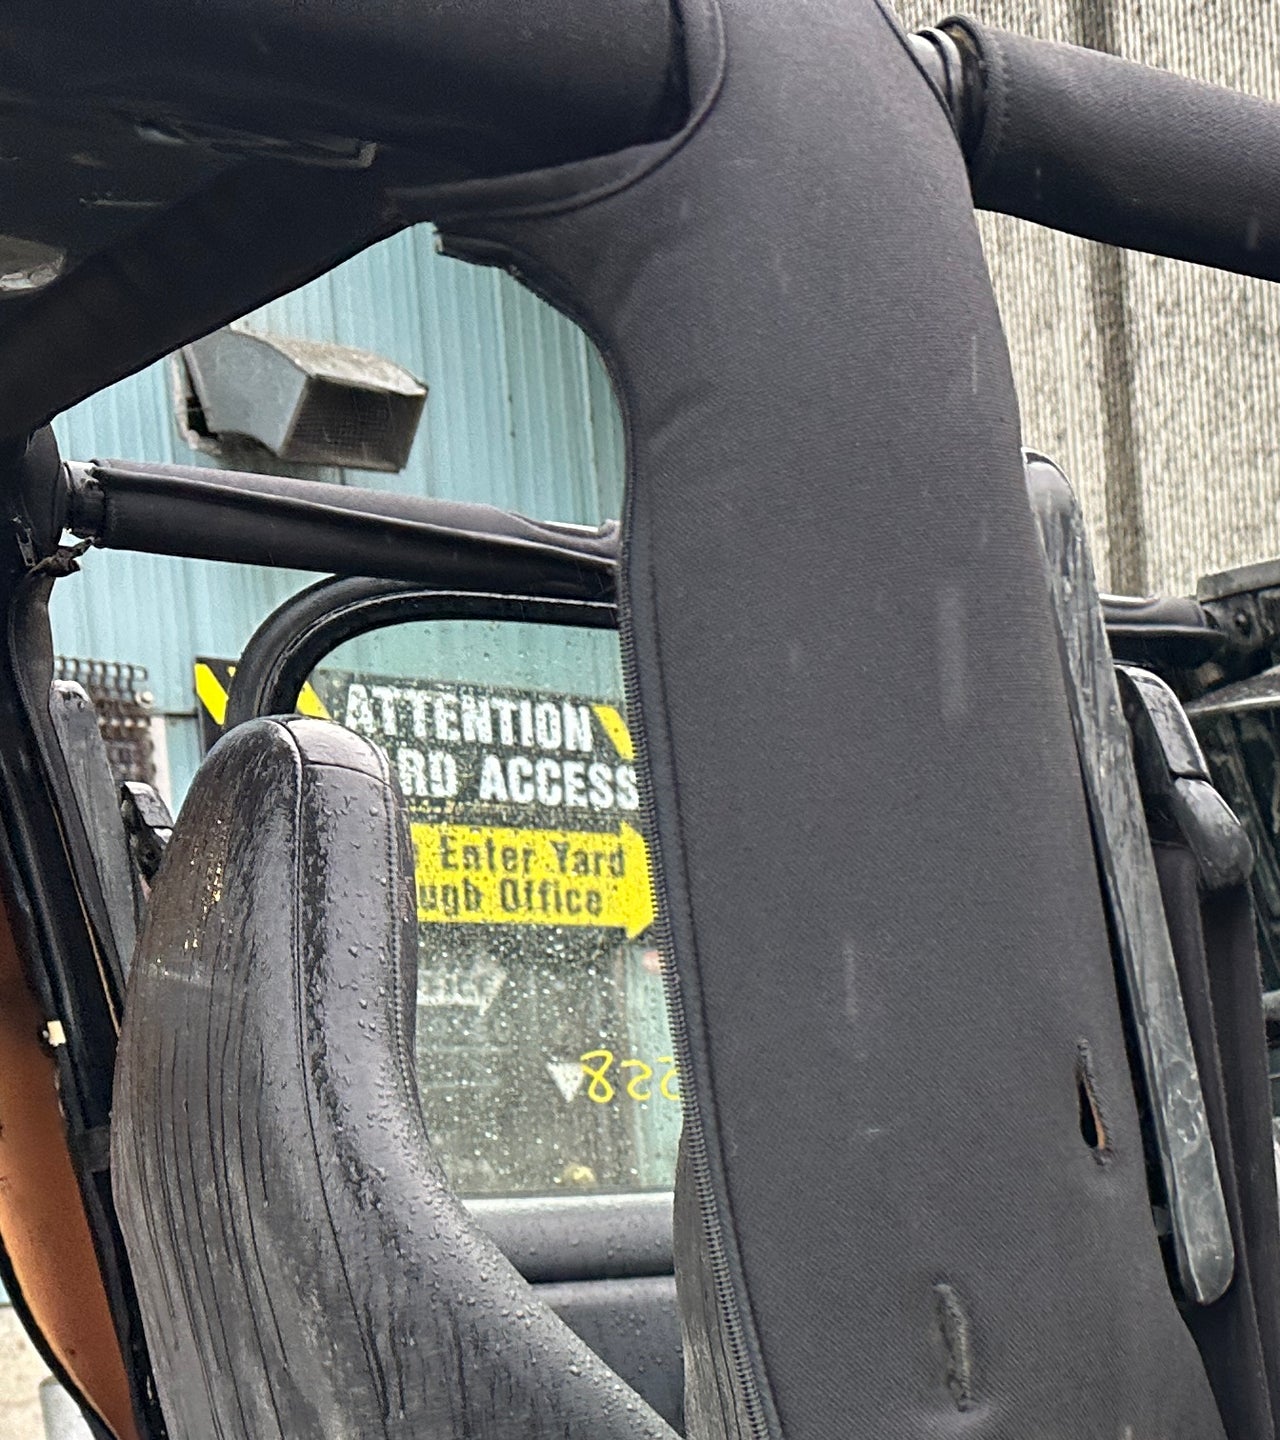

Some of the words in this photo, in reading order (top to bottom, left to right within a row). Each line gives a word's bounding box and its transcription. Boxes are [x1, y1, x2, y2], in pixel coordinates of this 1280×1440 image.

[345, 683, 594, 751] ATTENTION
[397, 747, 458, 798] RD
[479, 754, 640, 811] ACCESS
[440, 833, 534, 874] Enter
[550, 840, 626, 878] Yard
[418, 877, 482, 917] ugh
[500, 877, 604, 918] Office
